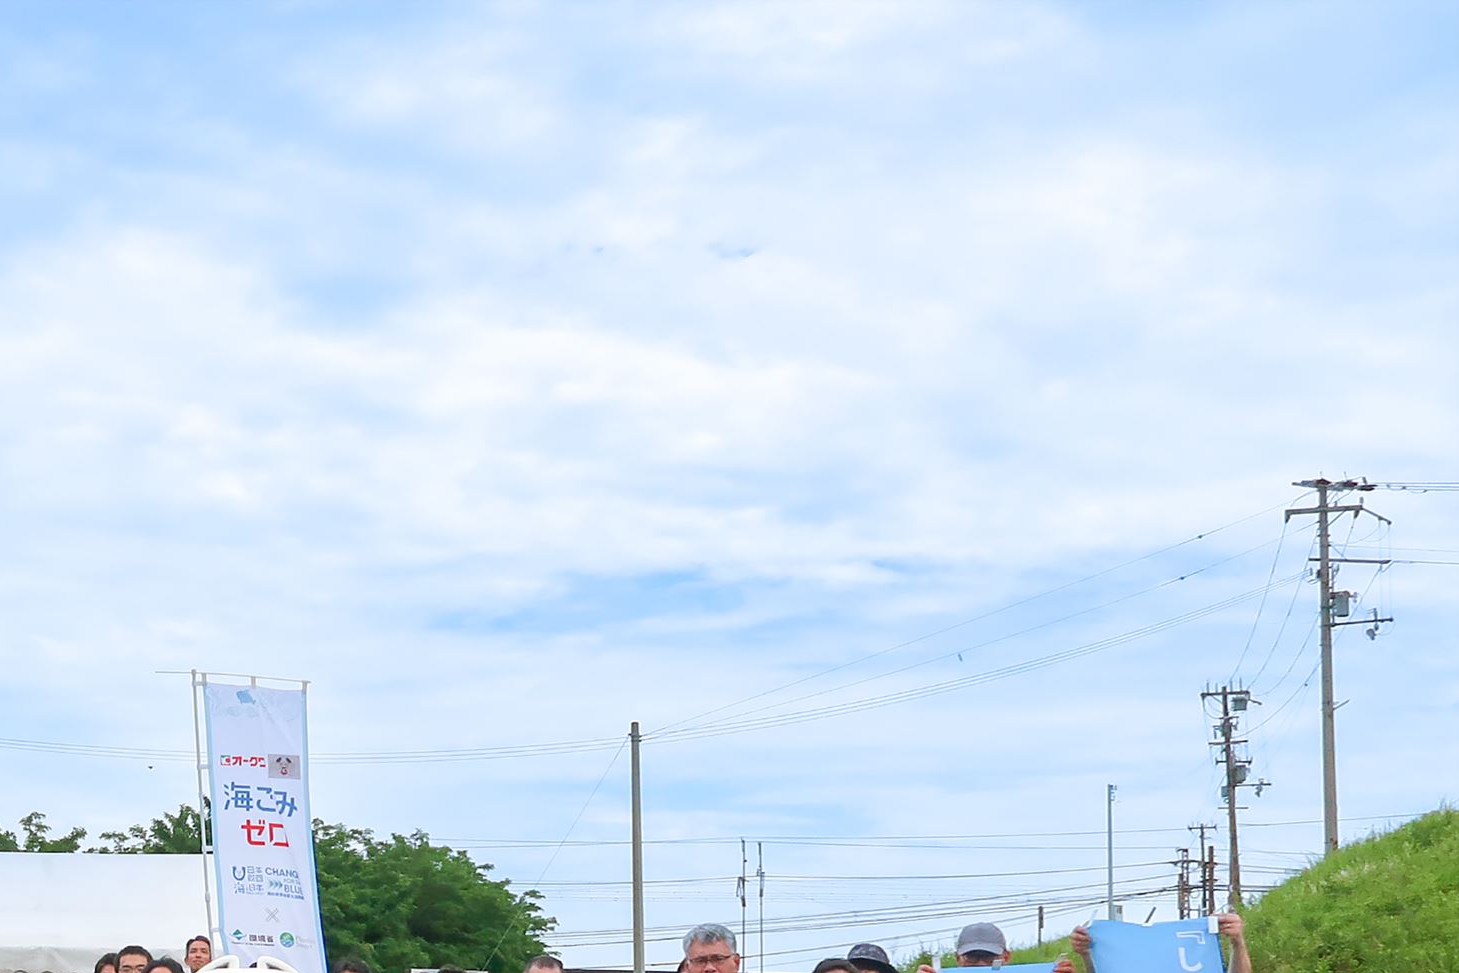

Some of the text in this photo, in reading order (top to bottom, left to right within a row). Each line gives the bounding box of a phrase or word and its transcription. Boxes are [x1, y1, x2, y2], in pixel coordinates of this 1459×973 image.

[223, 781, 298, 817] 海ごみ
[241, 819, 290, 848] ゼロ
